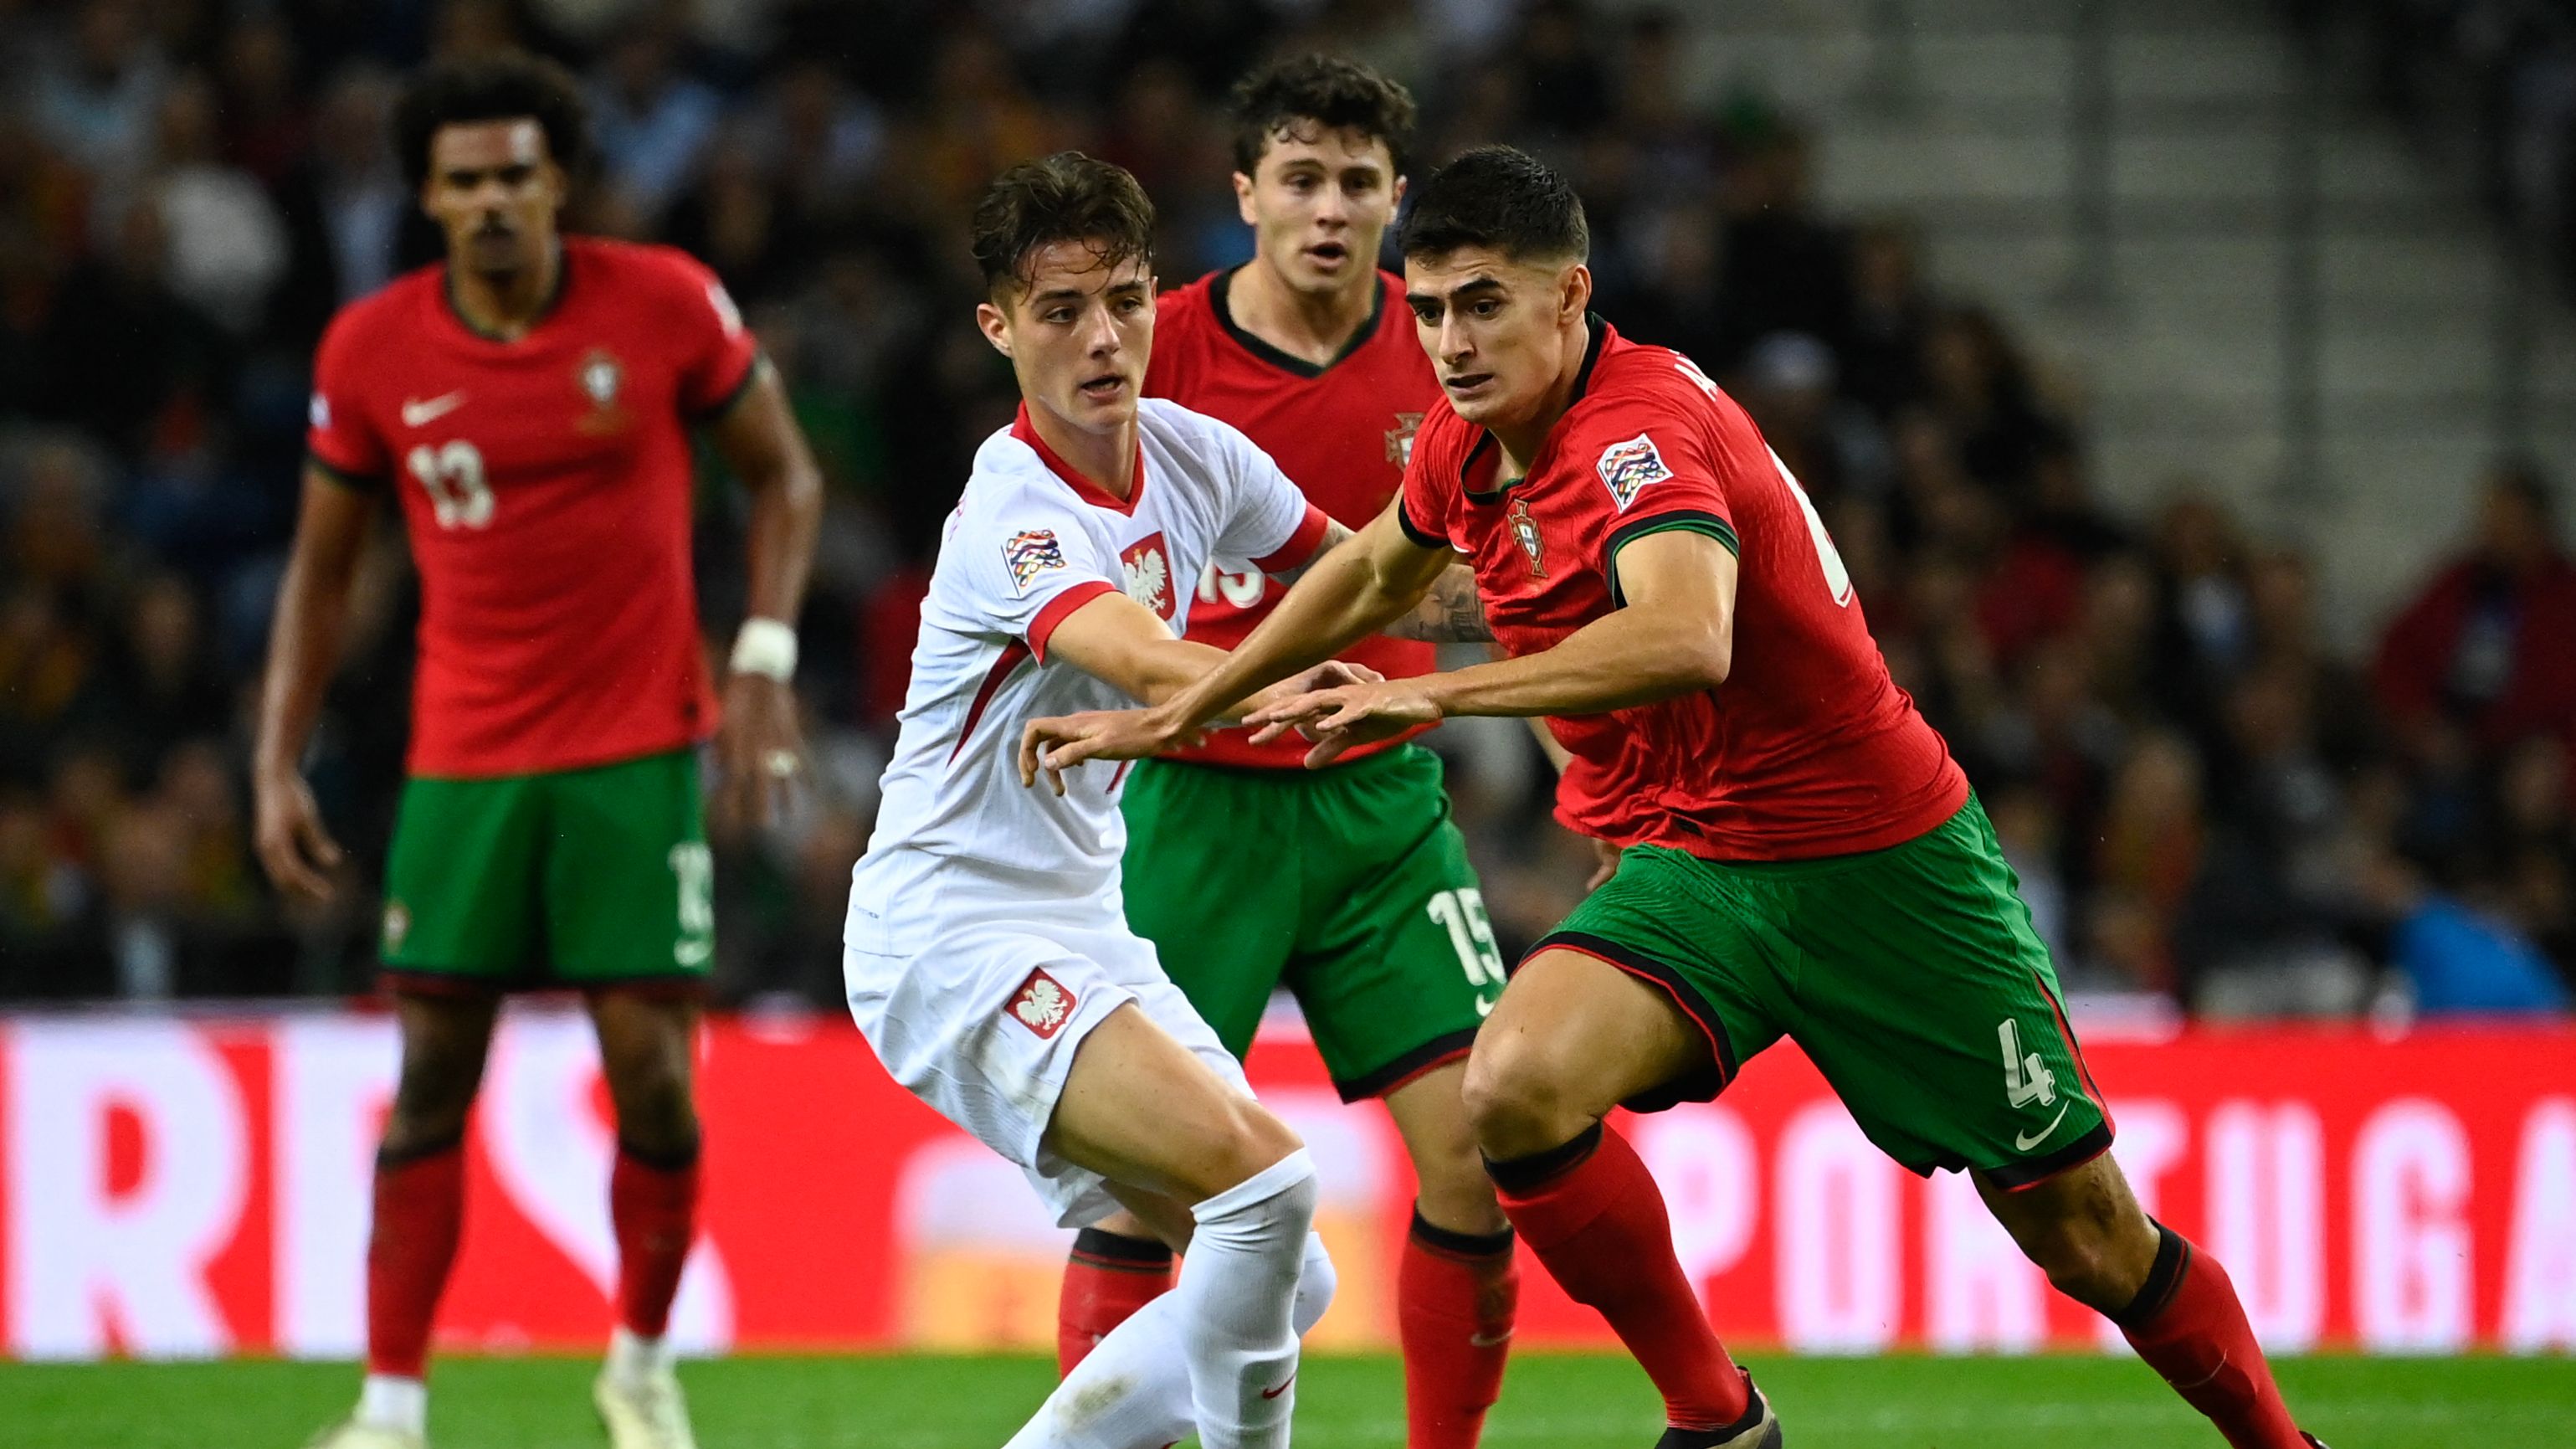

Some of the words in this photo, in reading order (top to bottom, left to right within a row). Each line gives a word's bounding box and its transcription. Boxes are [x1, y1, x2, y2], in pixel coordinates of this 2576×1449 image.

[406, 439, 496, 532] 13
[1426, 887, 1506, 986] 15
[1998, 1017, 2056, 1109] 4
